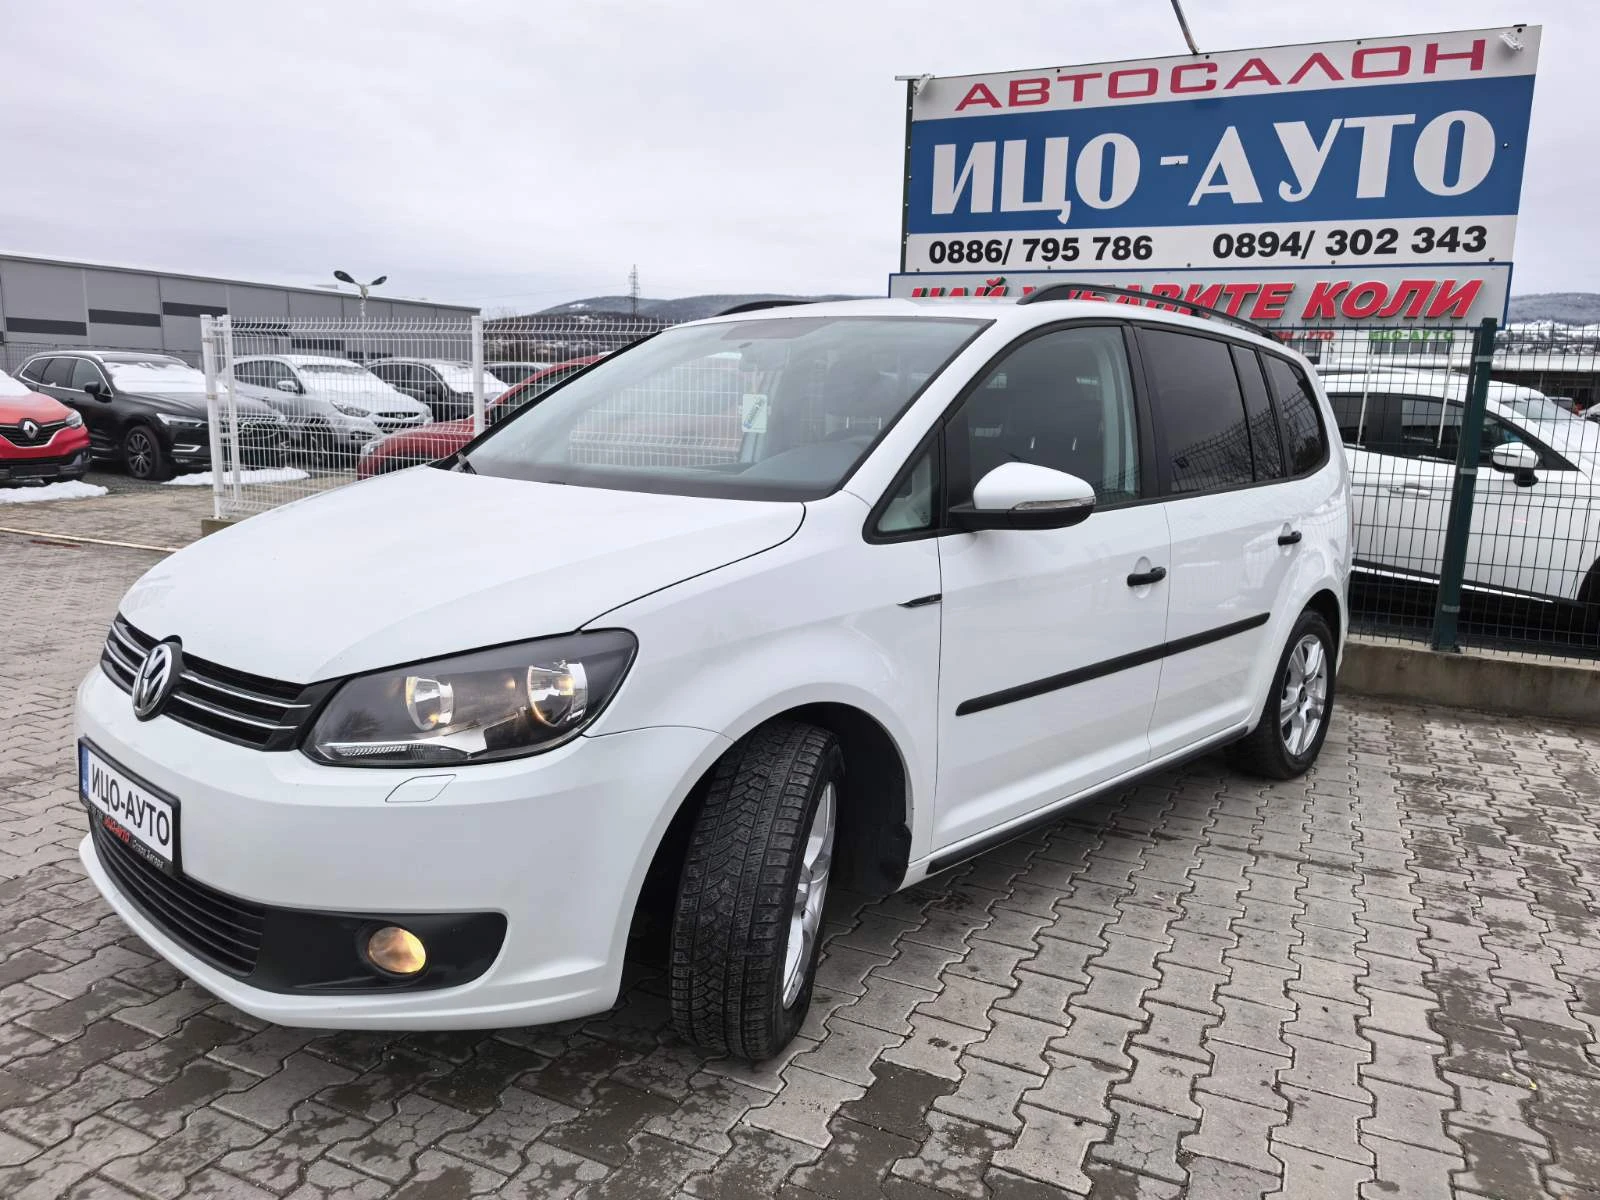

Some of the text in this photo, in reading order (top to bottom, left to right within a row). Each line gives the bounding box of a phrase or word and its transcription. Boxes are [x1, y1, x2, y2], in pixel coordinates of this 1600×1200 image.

[955, 39, 1486, 111] АВТОСАЛОН
[929, 235, 1153, 265] 0886/ 795 786
[1212, 225, 1487, 260] 0894/ 302 343
[1300, 278, 1484, 320] КОЛИ
[92, 763, 170, 846] ИЦО-АУТО
